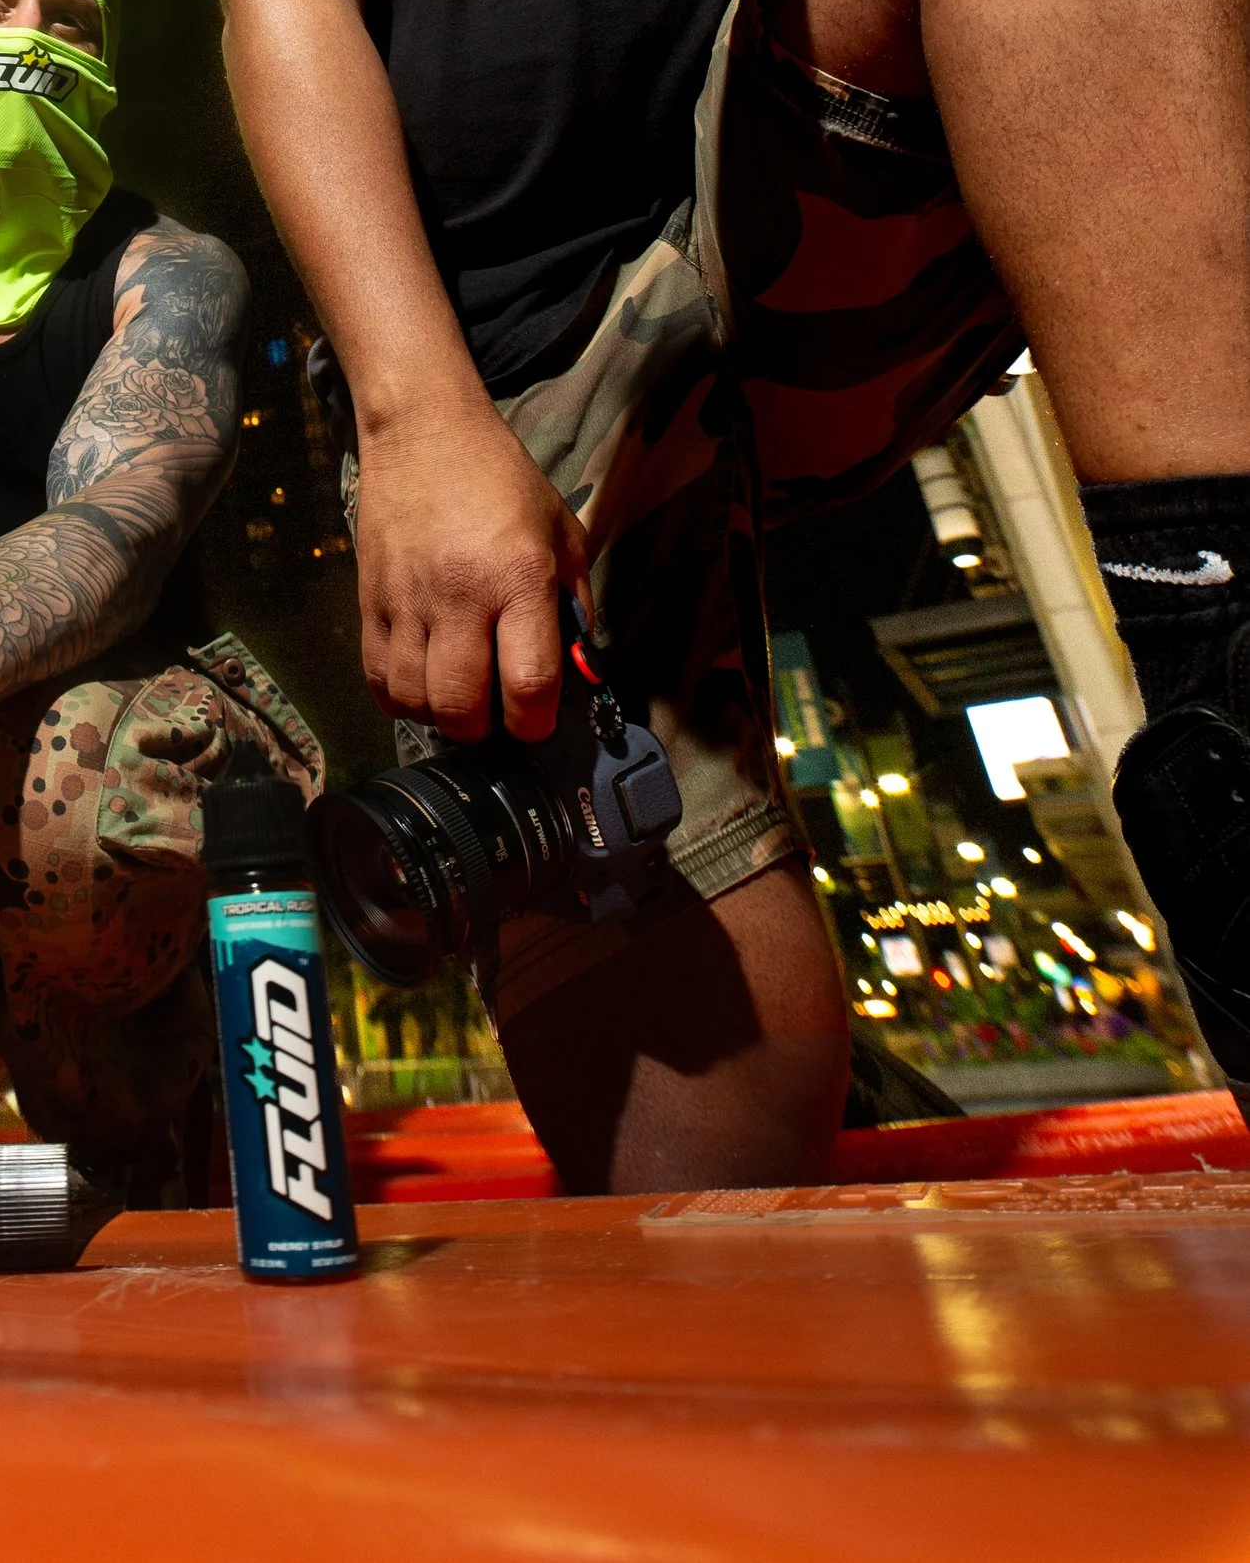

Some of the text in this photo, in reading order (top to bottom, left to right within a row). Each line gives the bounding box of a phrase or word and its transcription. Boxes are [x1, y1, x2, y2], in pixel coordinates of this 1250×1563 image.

[527, 807, 550, 861] COMLITE
[577, 786, 605, 848] Canon
[222, 901, 284, 917] TROPICAL
[250, 958, 333, 1222] FLUID
